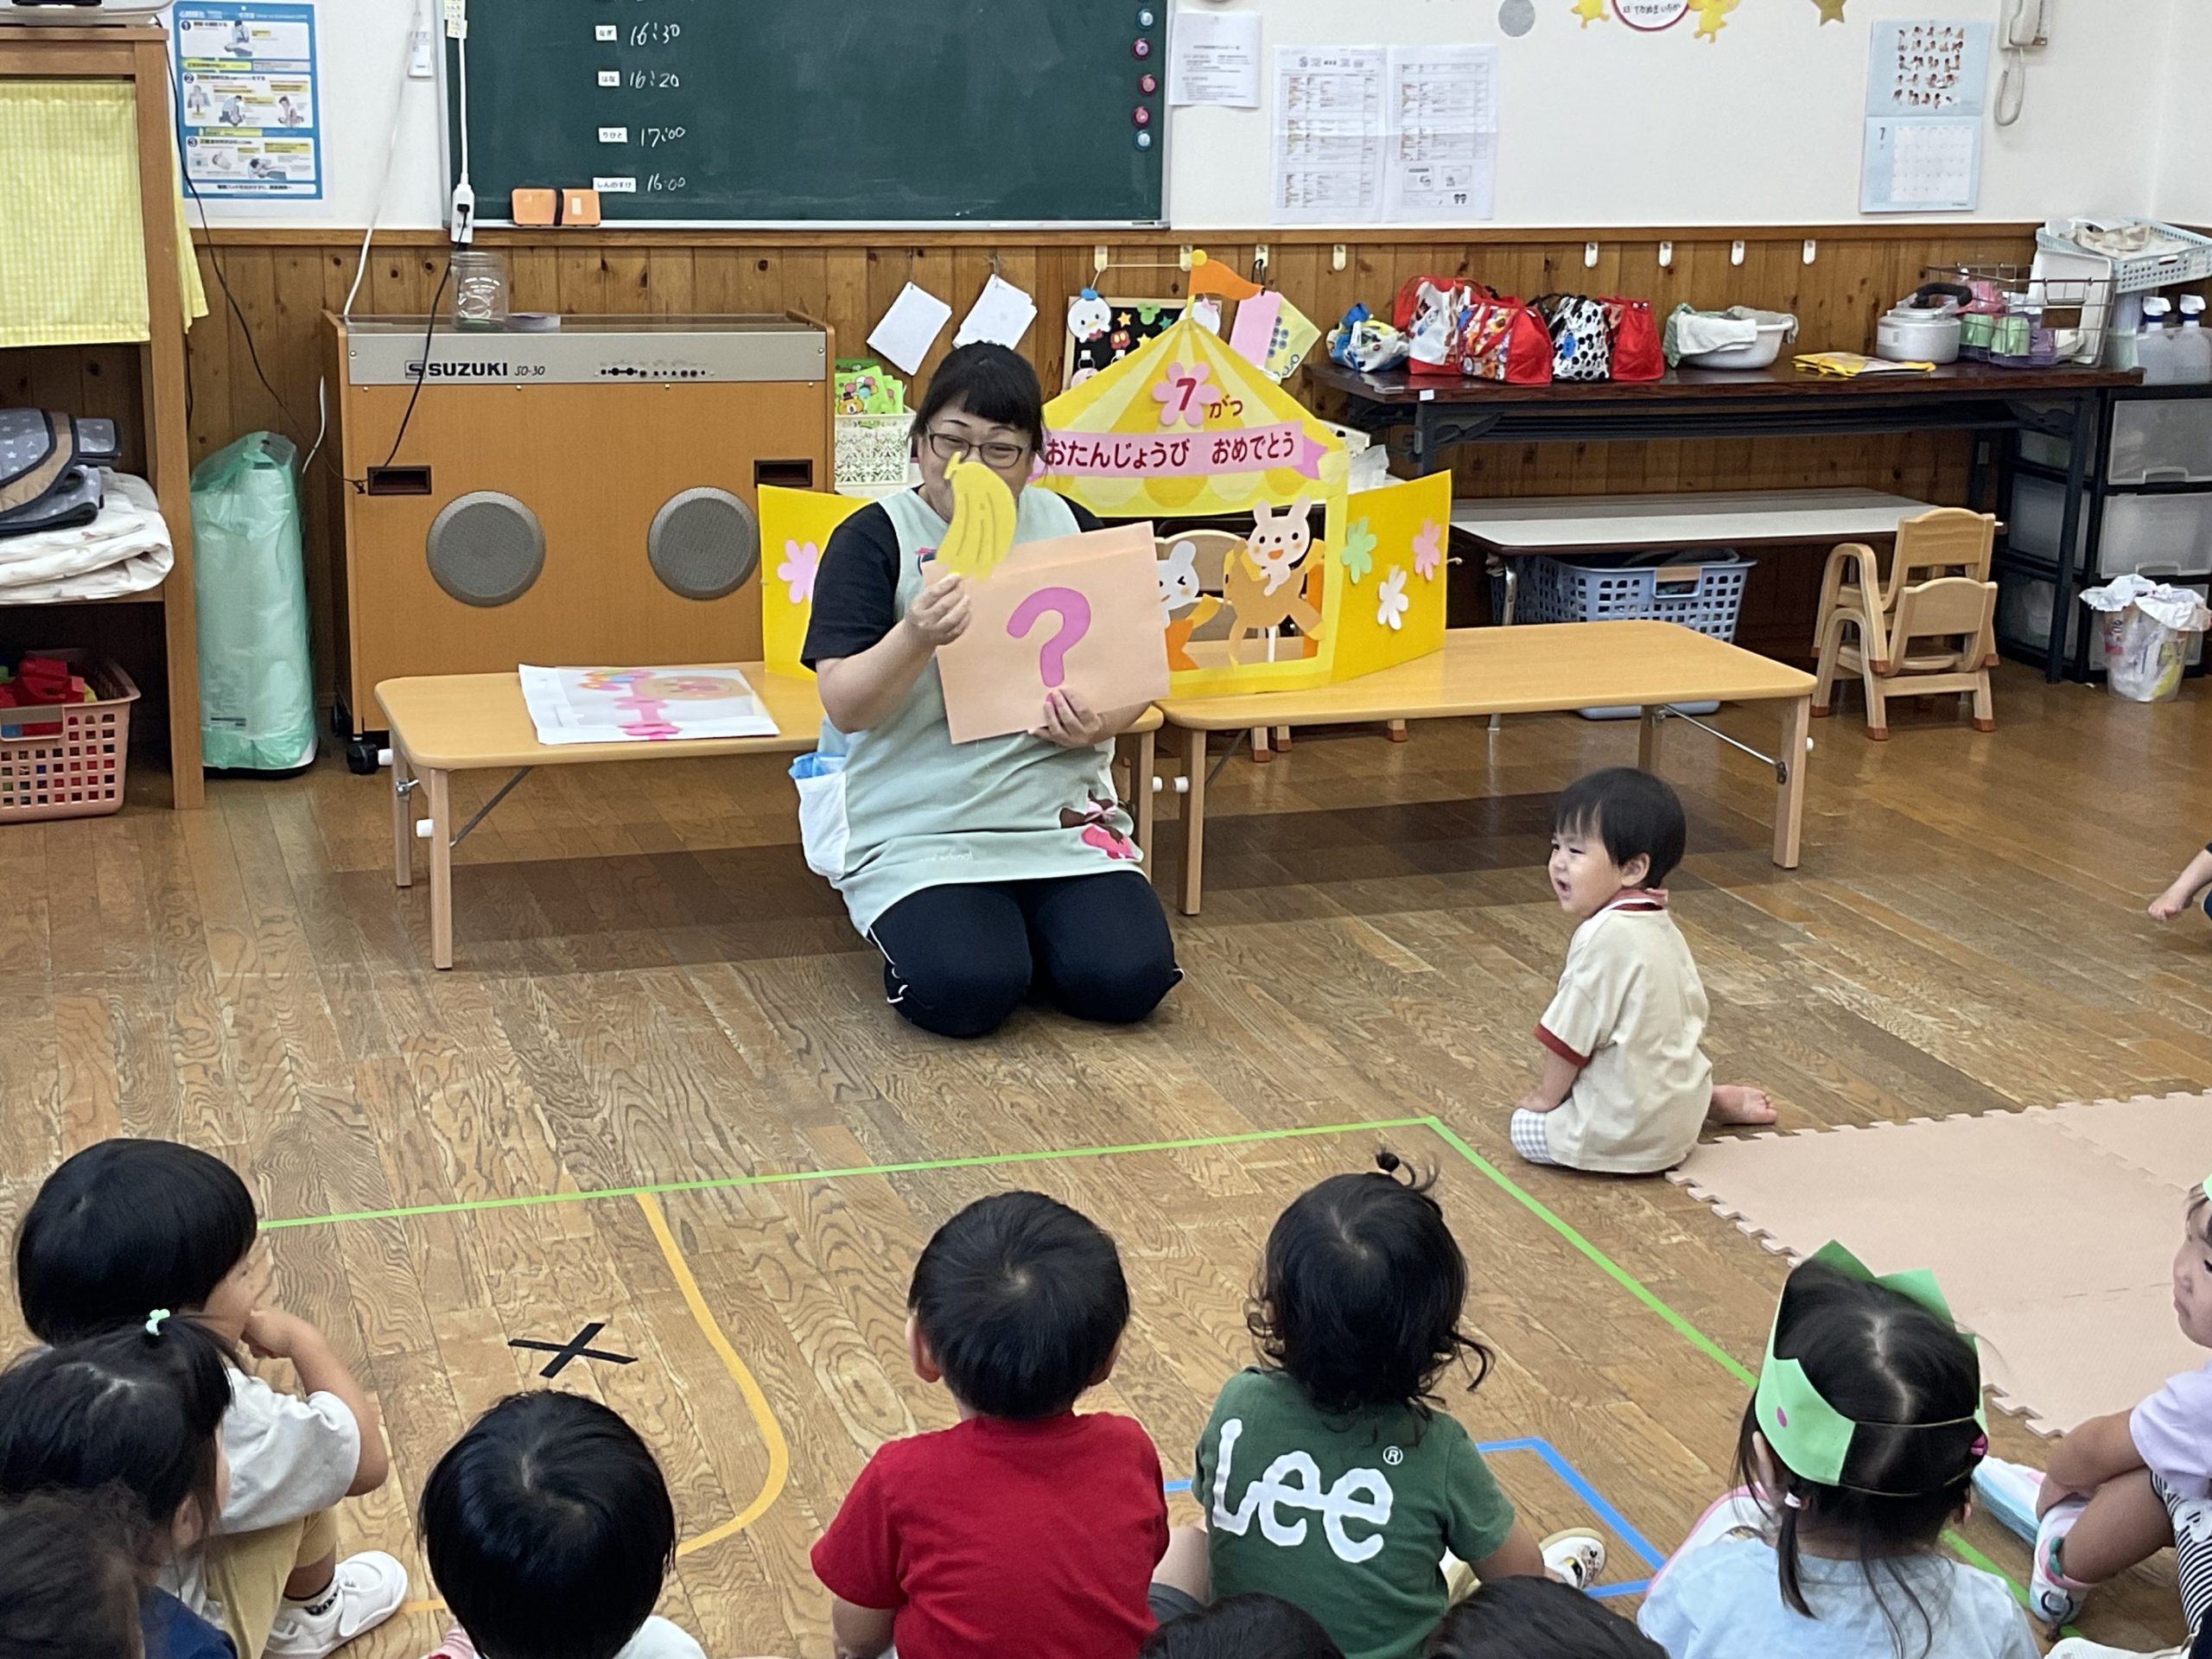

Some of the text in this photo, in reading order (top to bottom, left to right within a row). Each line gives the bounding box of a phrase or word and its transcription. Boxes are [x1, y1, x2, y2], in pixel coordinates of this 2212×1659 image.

[630, 22, 680, 47] 16:30
[629, 70, 679, 89] 16:20
[640, 126, 686, 148] 17:00
[1879, 127, 1885, 140] 7
[646, 173, 686, 192] 16:00
[428, 362, 508, 377] SUZUKI
[1175, 378, 1244, 419] 7 がつ
[1046, 431, 1295, 469] おたんじょうび おめでとう
[1212, 1418, 1394, 1563] Lee
